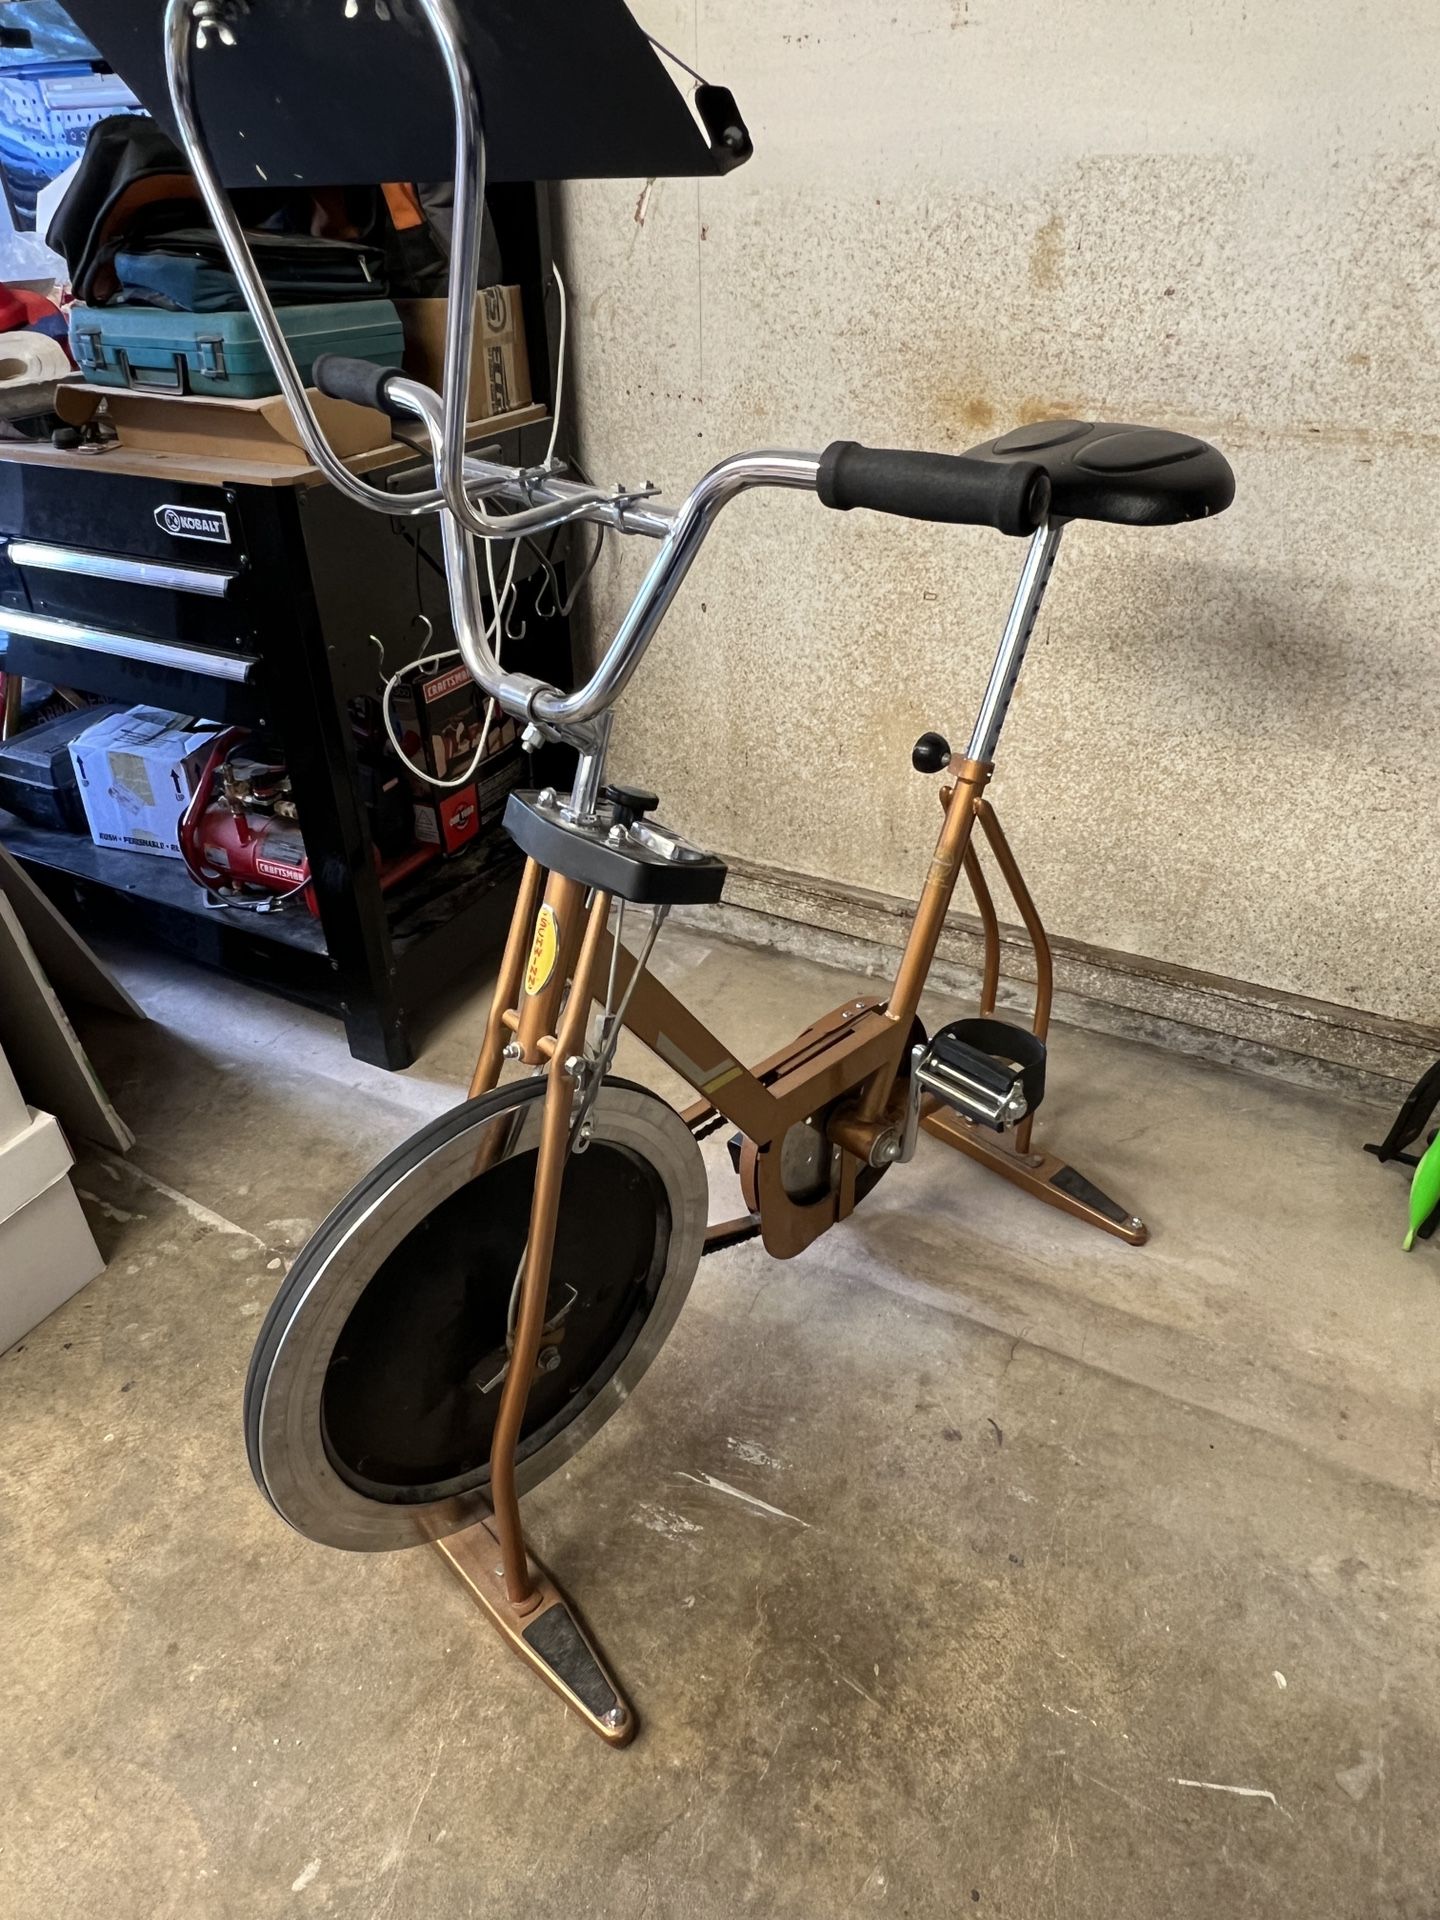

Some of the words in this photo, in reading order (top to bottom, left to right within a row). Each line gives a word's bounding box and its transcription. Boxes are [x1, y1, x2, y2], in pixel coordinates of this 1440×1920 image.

[180, 516, 220, 533] KOBALT
[427, 668, 471, 697] CRAFTSMA
[259, 863, 304, 882] CRAFTSMAN
[528, 917, 548, 986] SCHWINN
